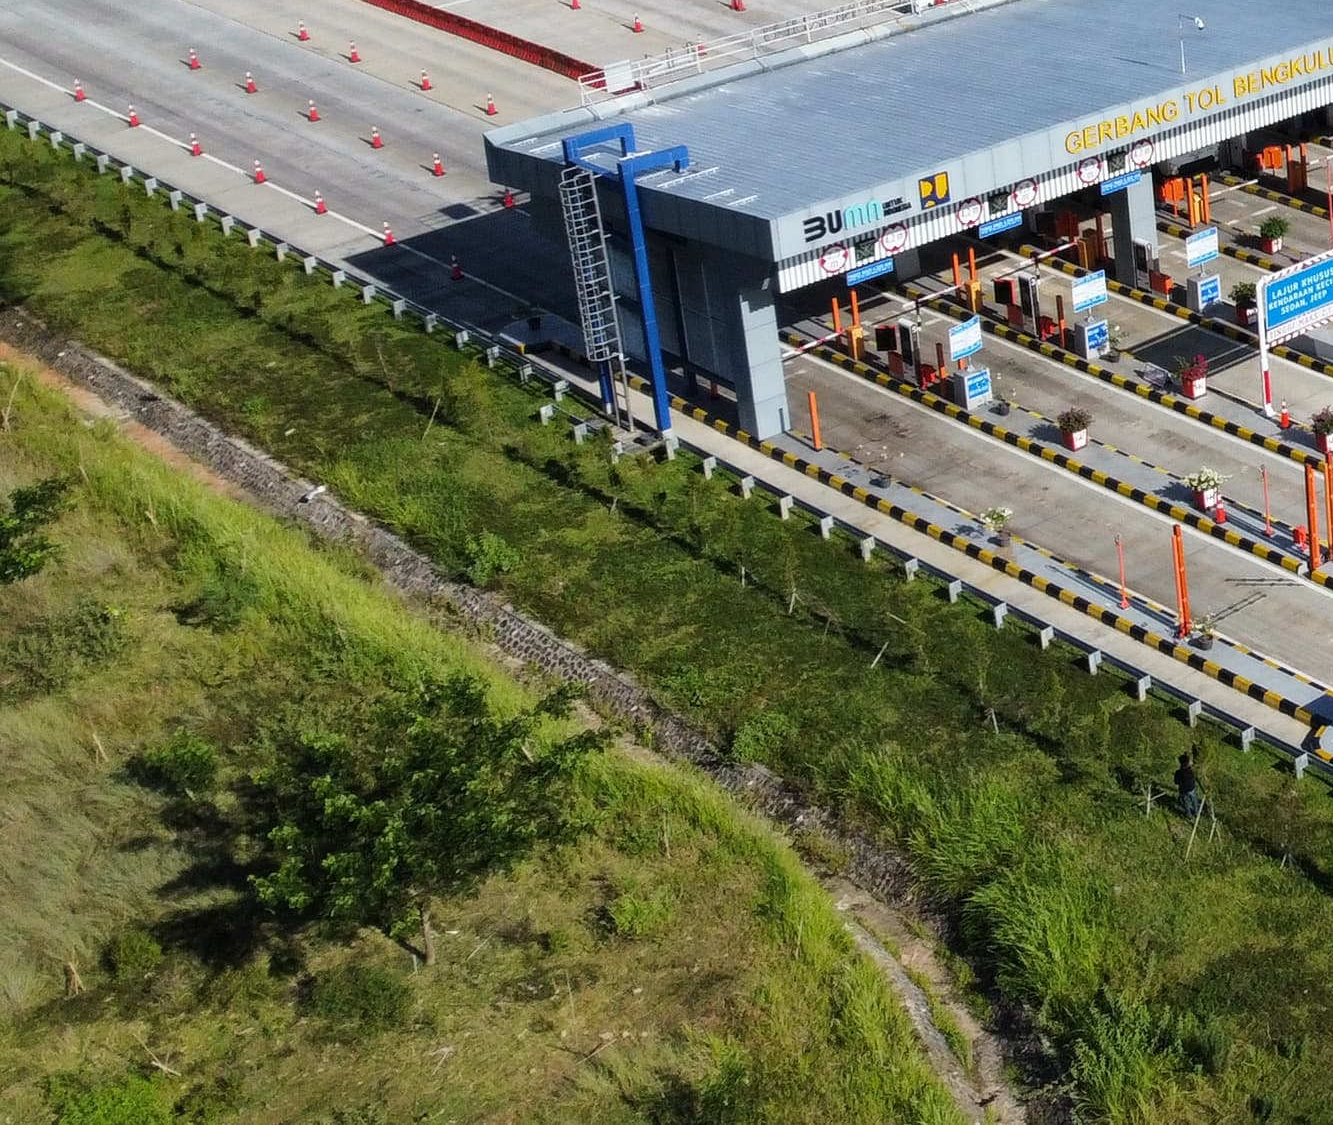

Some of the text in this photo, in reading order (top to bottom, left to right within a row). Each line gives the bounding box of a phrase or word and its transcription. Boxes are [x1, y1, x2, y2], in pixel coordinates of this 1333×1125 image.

[1065, 100, 1179, 154] GERBANG
[1184, 84, 1228, 114] TOL
[1268, 286, 1314, 311] KENDARAAN
[1271, 282, 1299, 300] LAJUR
[1280, 298, 1308, 316] SEDAN,
[1310, 289, 1328, 303] JEEP
